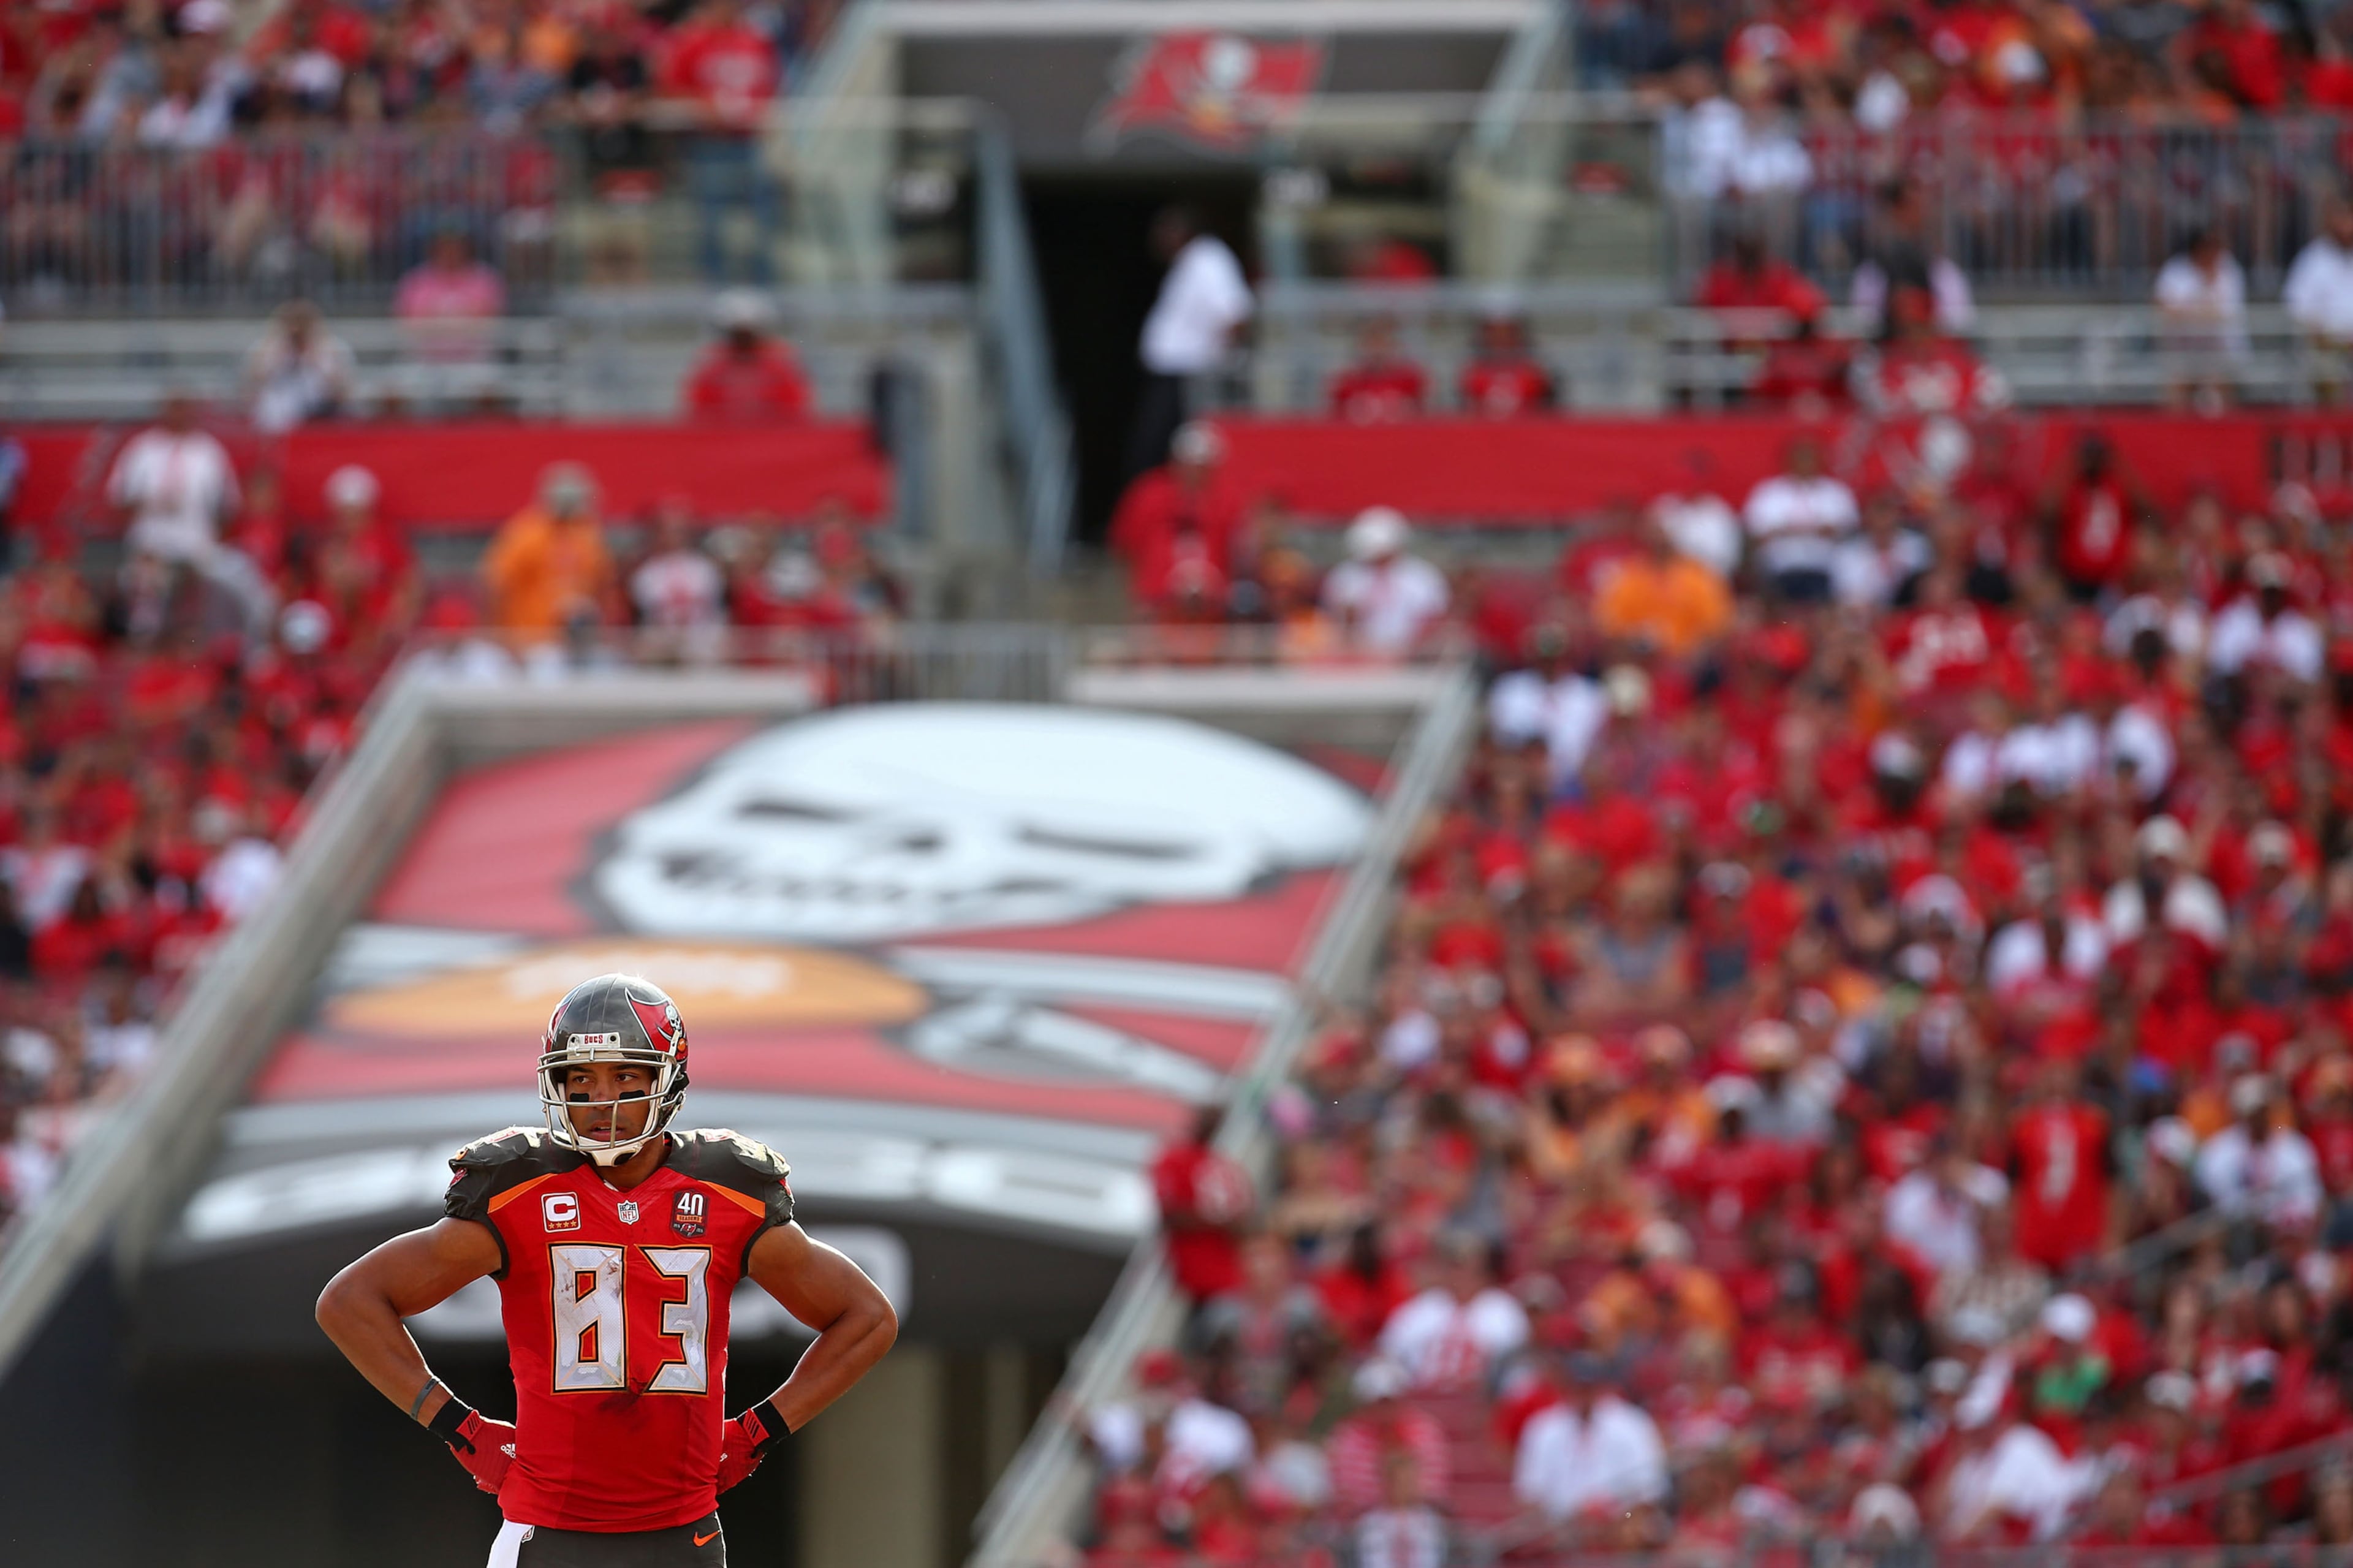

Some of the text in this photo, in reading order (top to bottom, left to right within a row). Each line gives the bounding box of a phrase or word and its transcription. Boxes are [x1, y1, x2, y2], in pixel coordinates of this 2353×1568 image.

[545, 1195, 577, 1222] C
[622, 1211, 636, 1219] NFL
[677, 1192, 703, 1216] 40
[547, 1241, 712, 1396] 83
